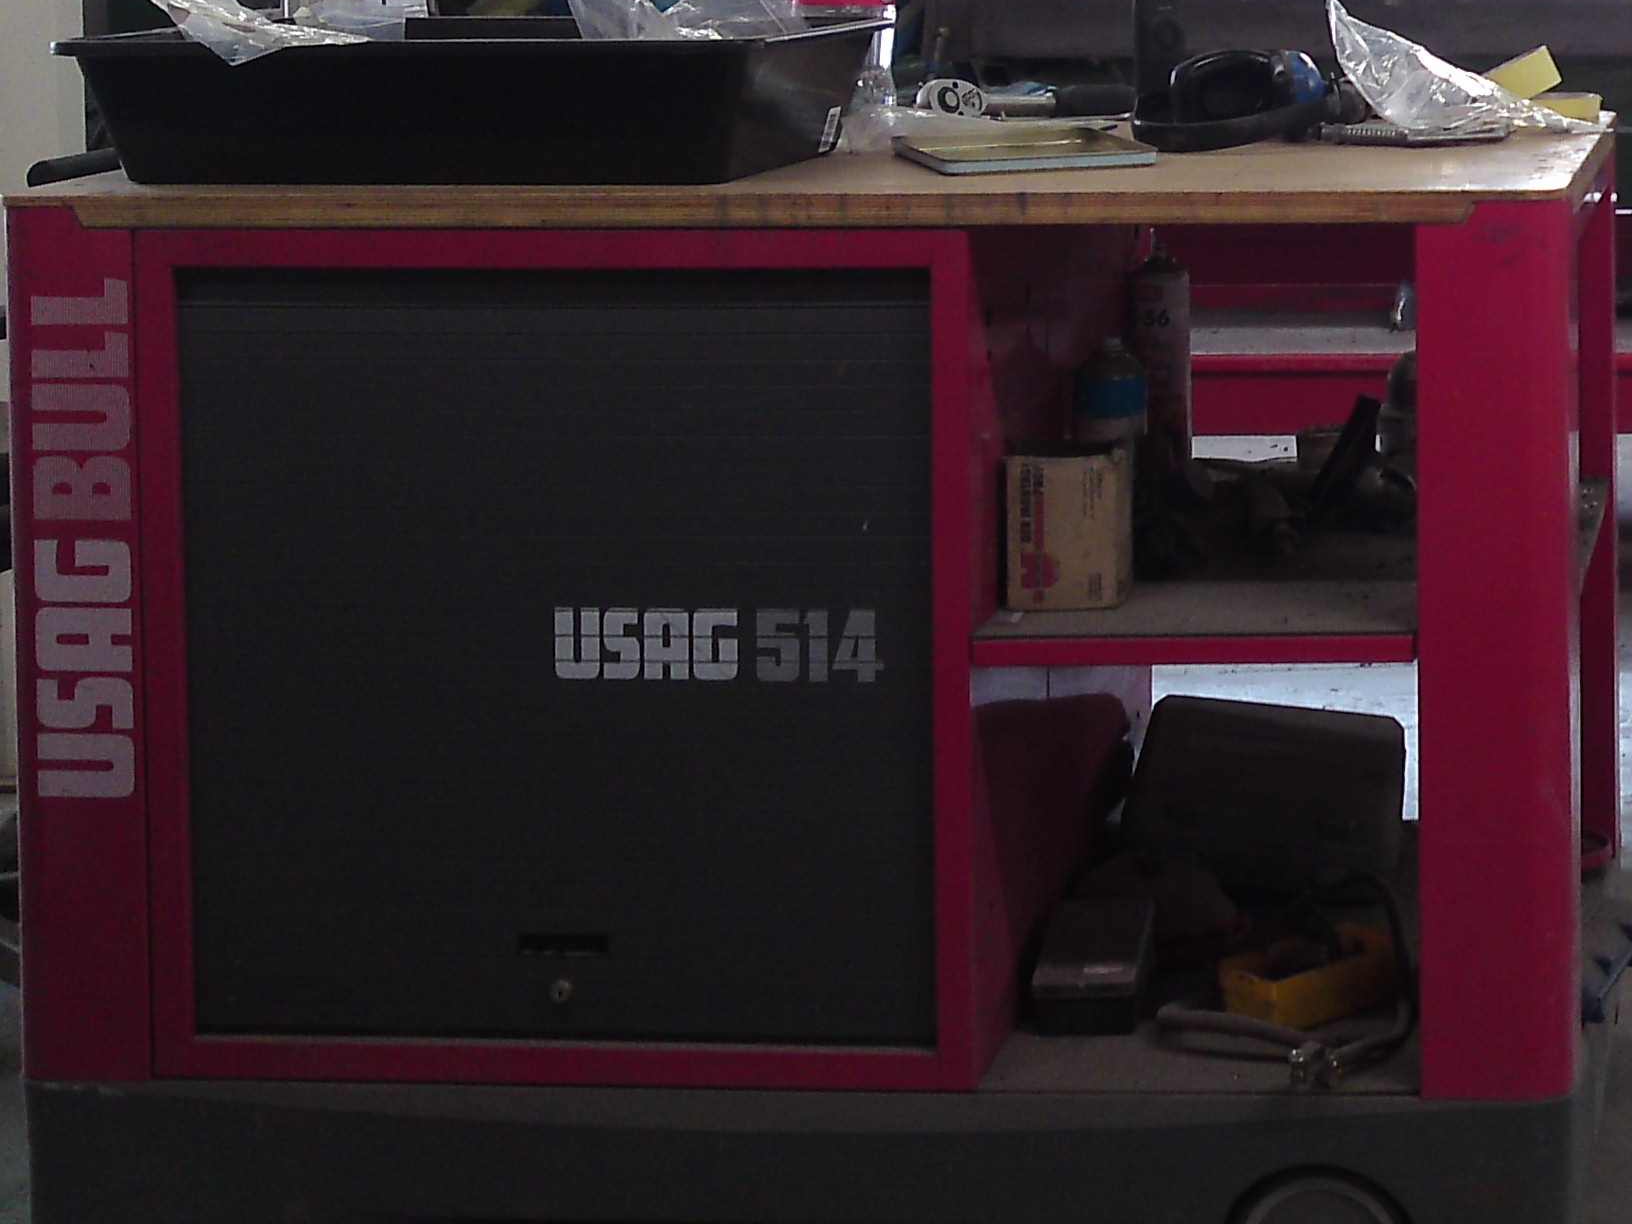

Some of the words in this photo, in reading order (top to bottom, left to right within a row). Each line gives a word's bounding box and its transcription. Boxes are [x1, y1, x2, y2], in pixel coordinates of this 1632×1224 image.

[29, 277, 132, 521] BULL
[33, 538, 136, 799] USAG
[553, 606, 739, 681] USAG
[755, 607, 886, 683] 514
